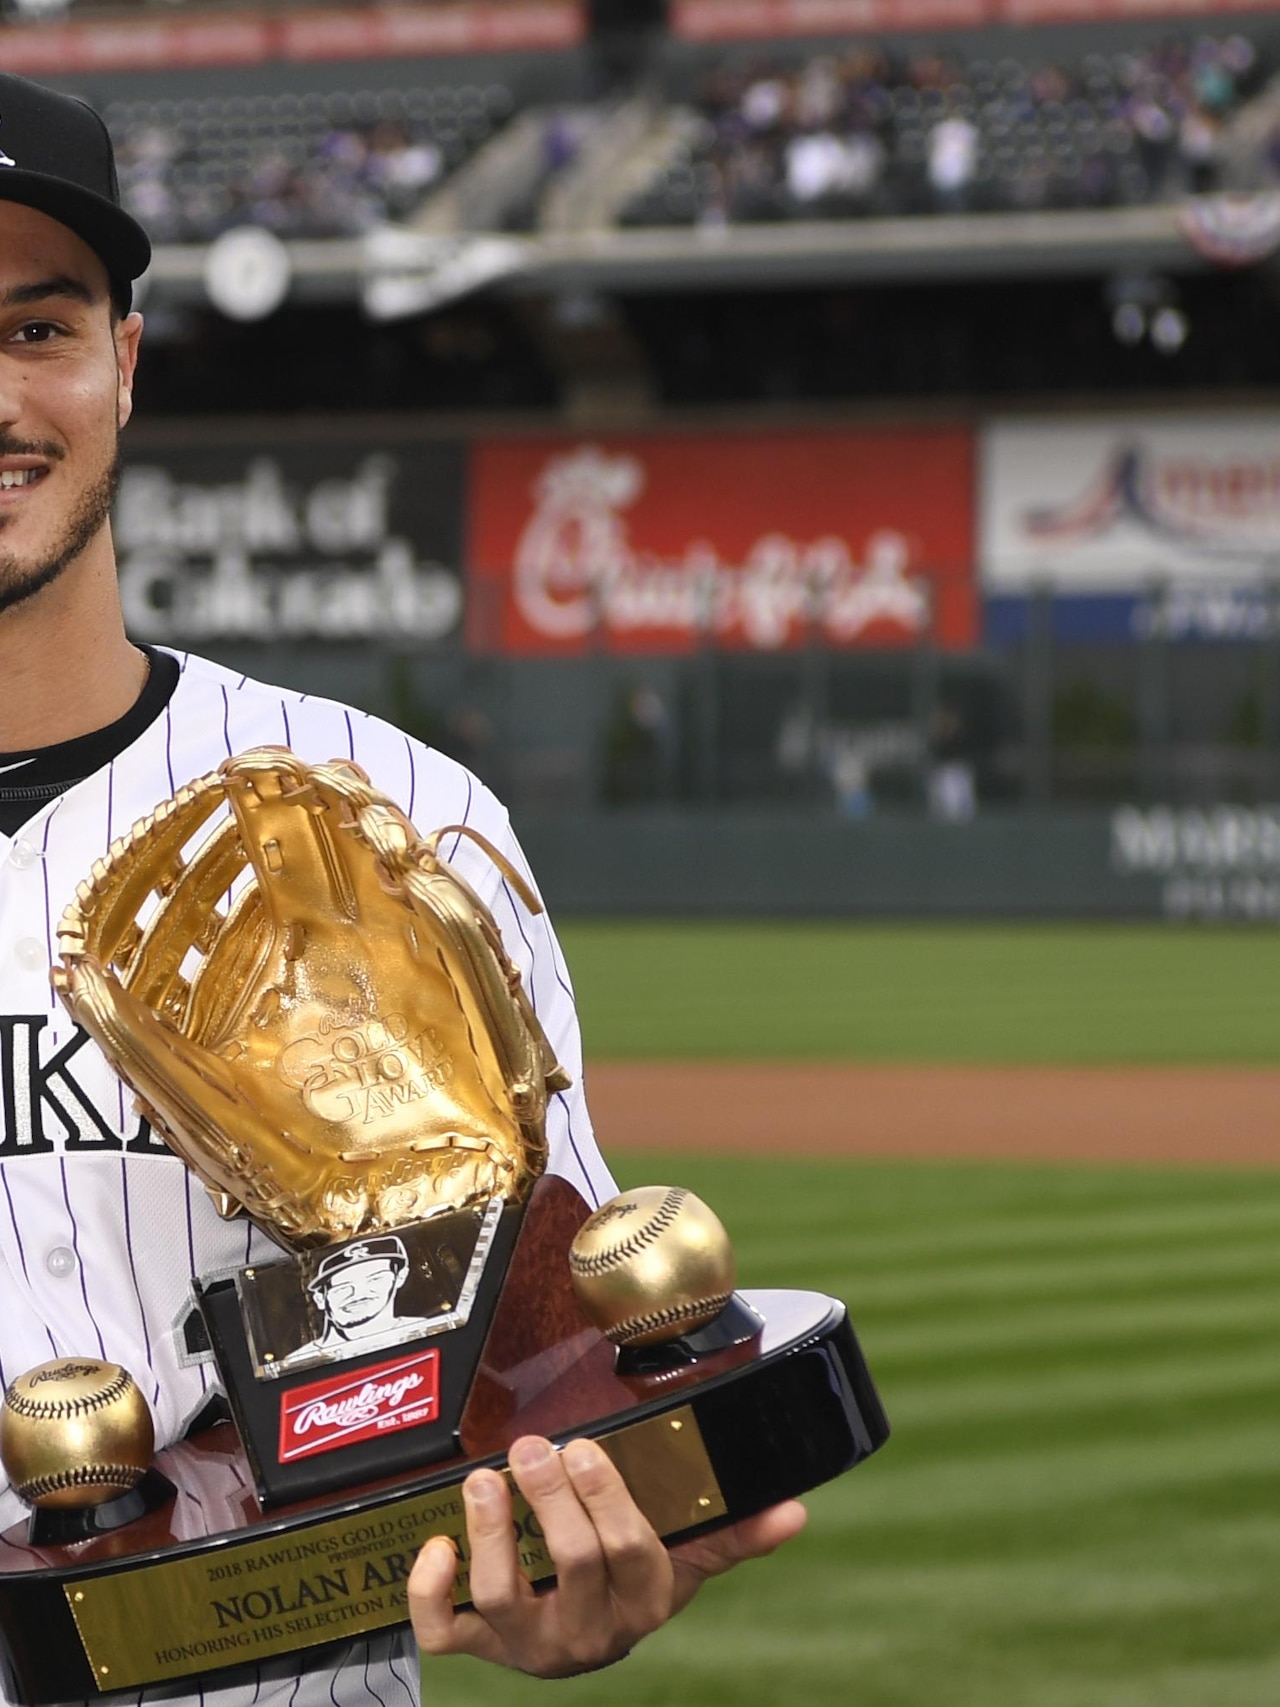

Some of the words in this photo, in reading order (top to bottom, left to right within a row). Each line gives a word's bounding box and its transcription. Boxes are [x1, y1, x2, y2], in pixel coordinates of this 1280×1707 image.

[30, 1363, 101, 1388] Rawlings
[293, 1373, 424, 1434] Rawlings
[207, 1562, 242, 1581] 2018
[245, 1535, 340, 1572] RAWLINGS
[342, 1521, 394, 1548] GOLD
[398, 1501, 460, 1531] GLOVE
[401, 1532, 416, 1544] TO
[209, 1567, 351, 1628] NOLAN
[155, 1632, 251, 1664] HONORING
[253, 1624, 283, 1643] HIS
[285, 1597, 384, 1635] SELECTION
